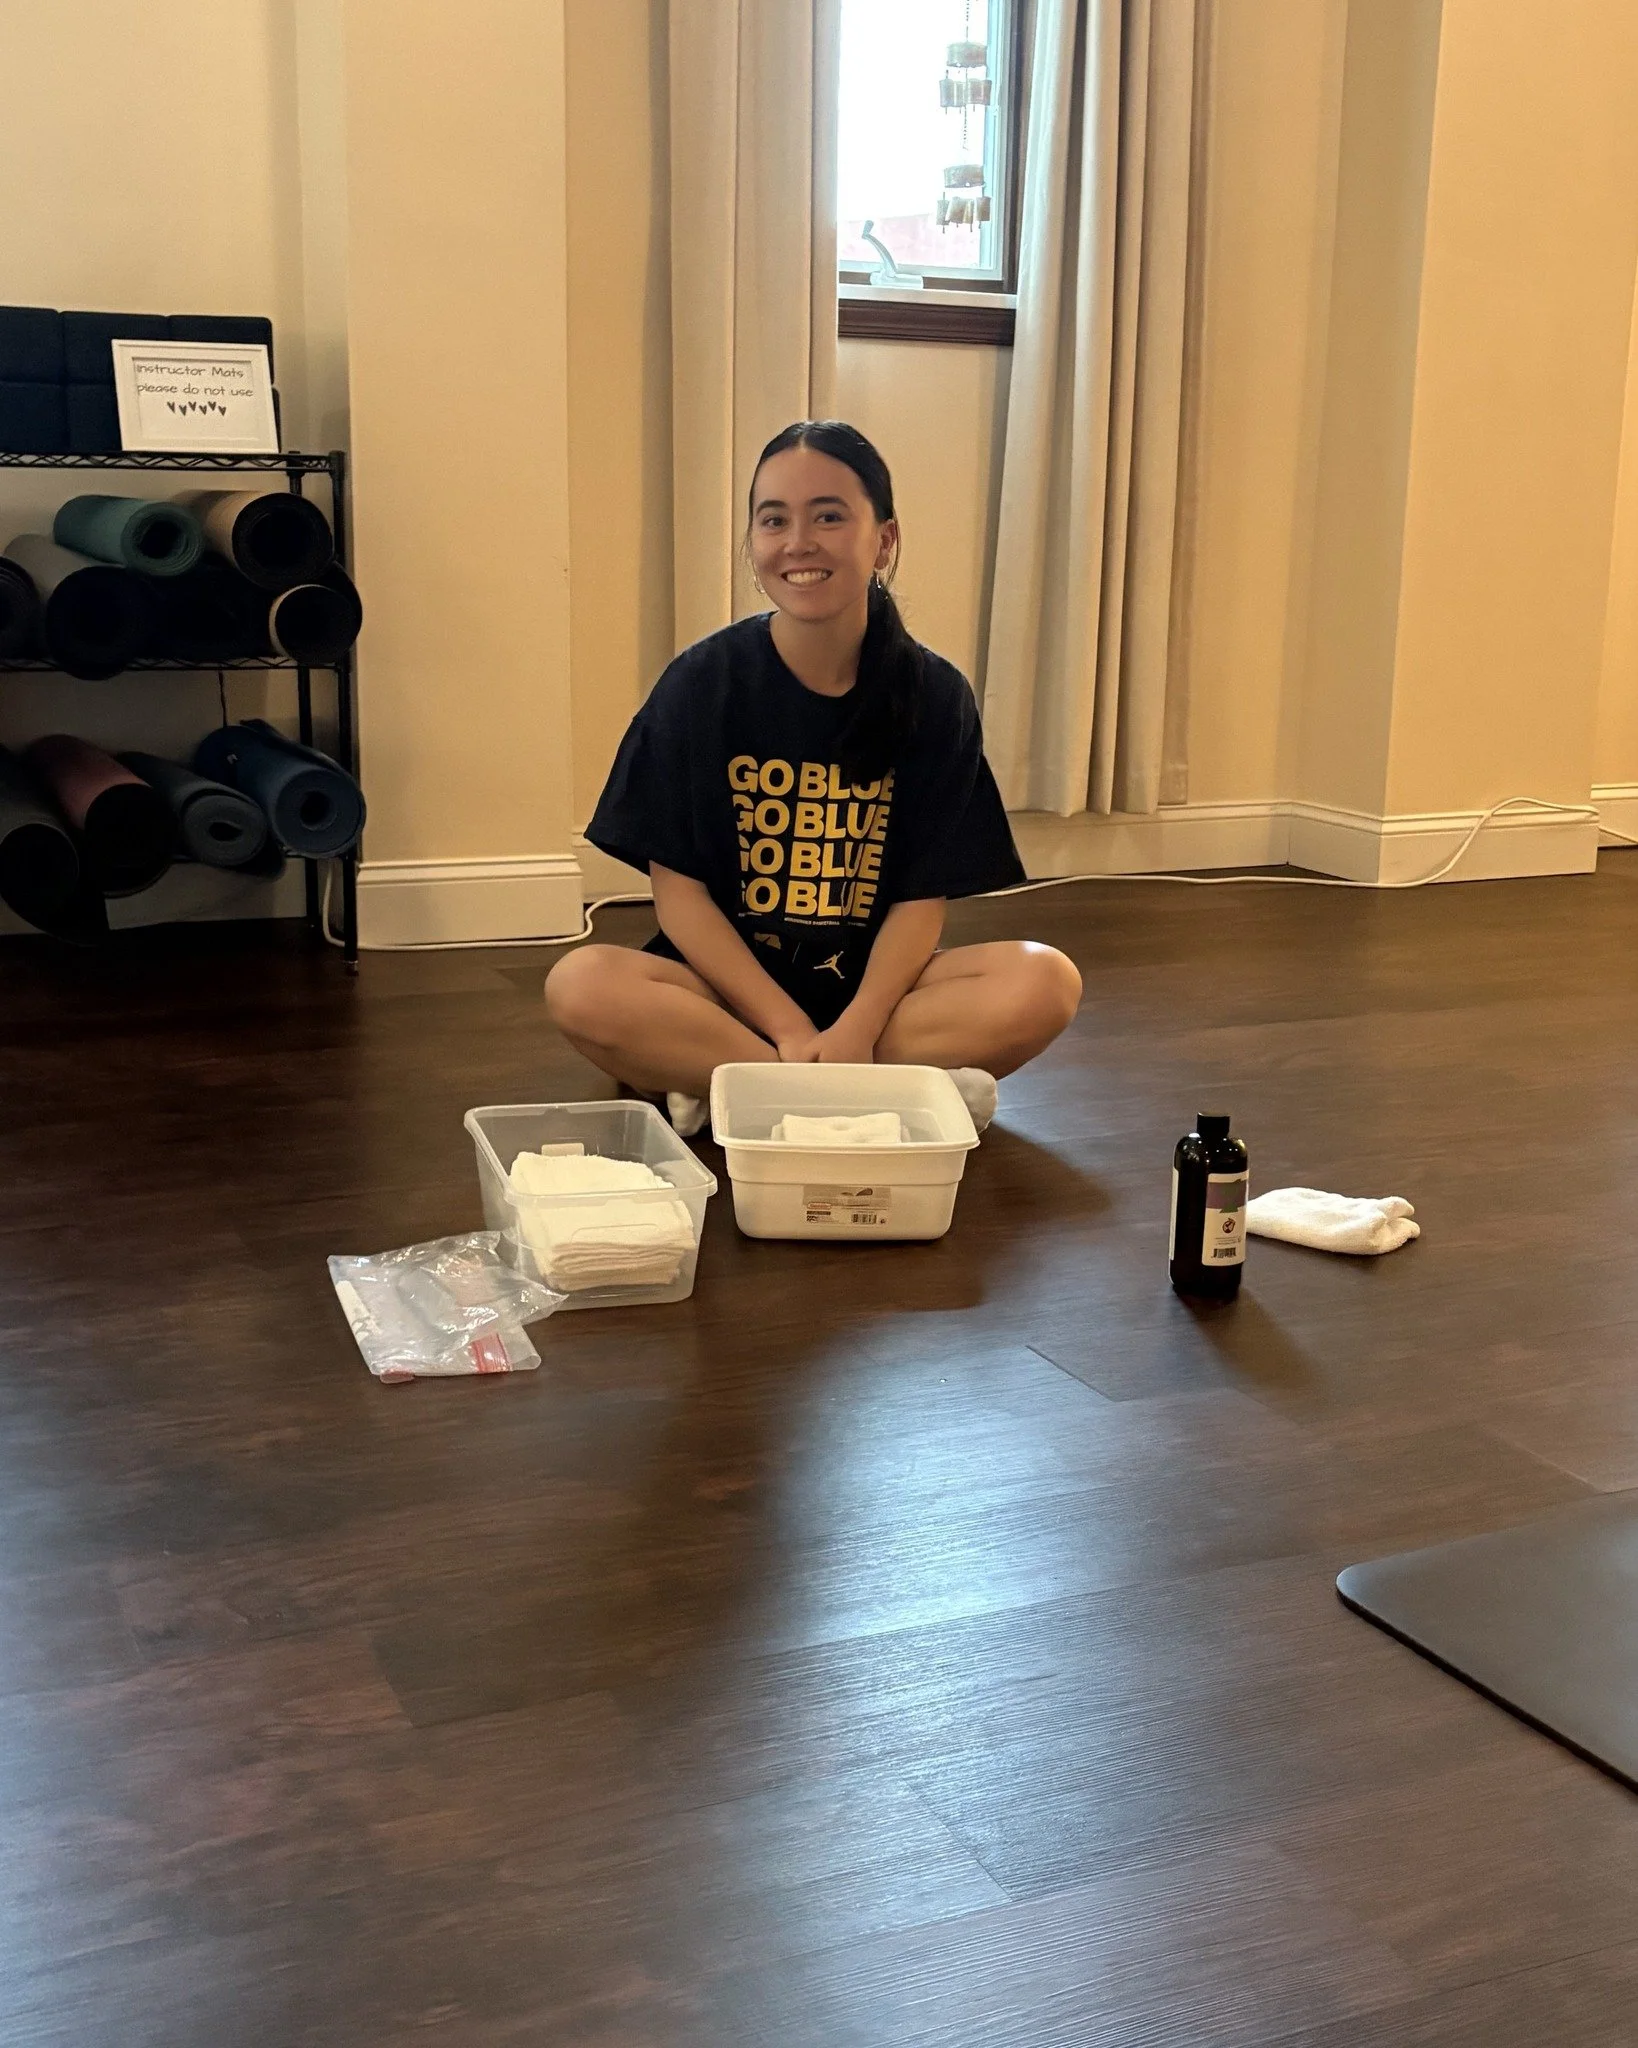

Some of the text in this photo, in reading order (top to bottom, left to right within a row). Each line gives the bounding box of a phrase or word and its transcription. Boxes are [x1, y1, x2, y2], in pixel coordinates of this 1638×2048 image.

[137, 364, 244, 378] Instructor Mats
[137, 383, 254, 397] please do not use
[728, 755, 794, 796] GO
[794, 801, 890, 841] BLUE
[789, 841, 884, 881] BLUE
[741, 878, 780, 913] O
